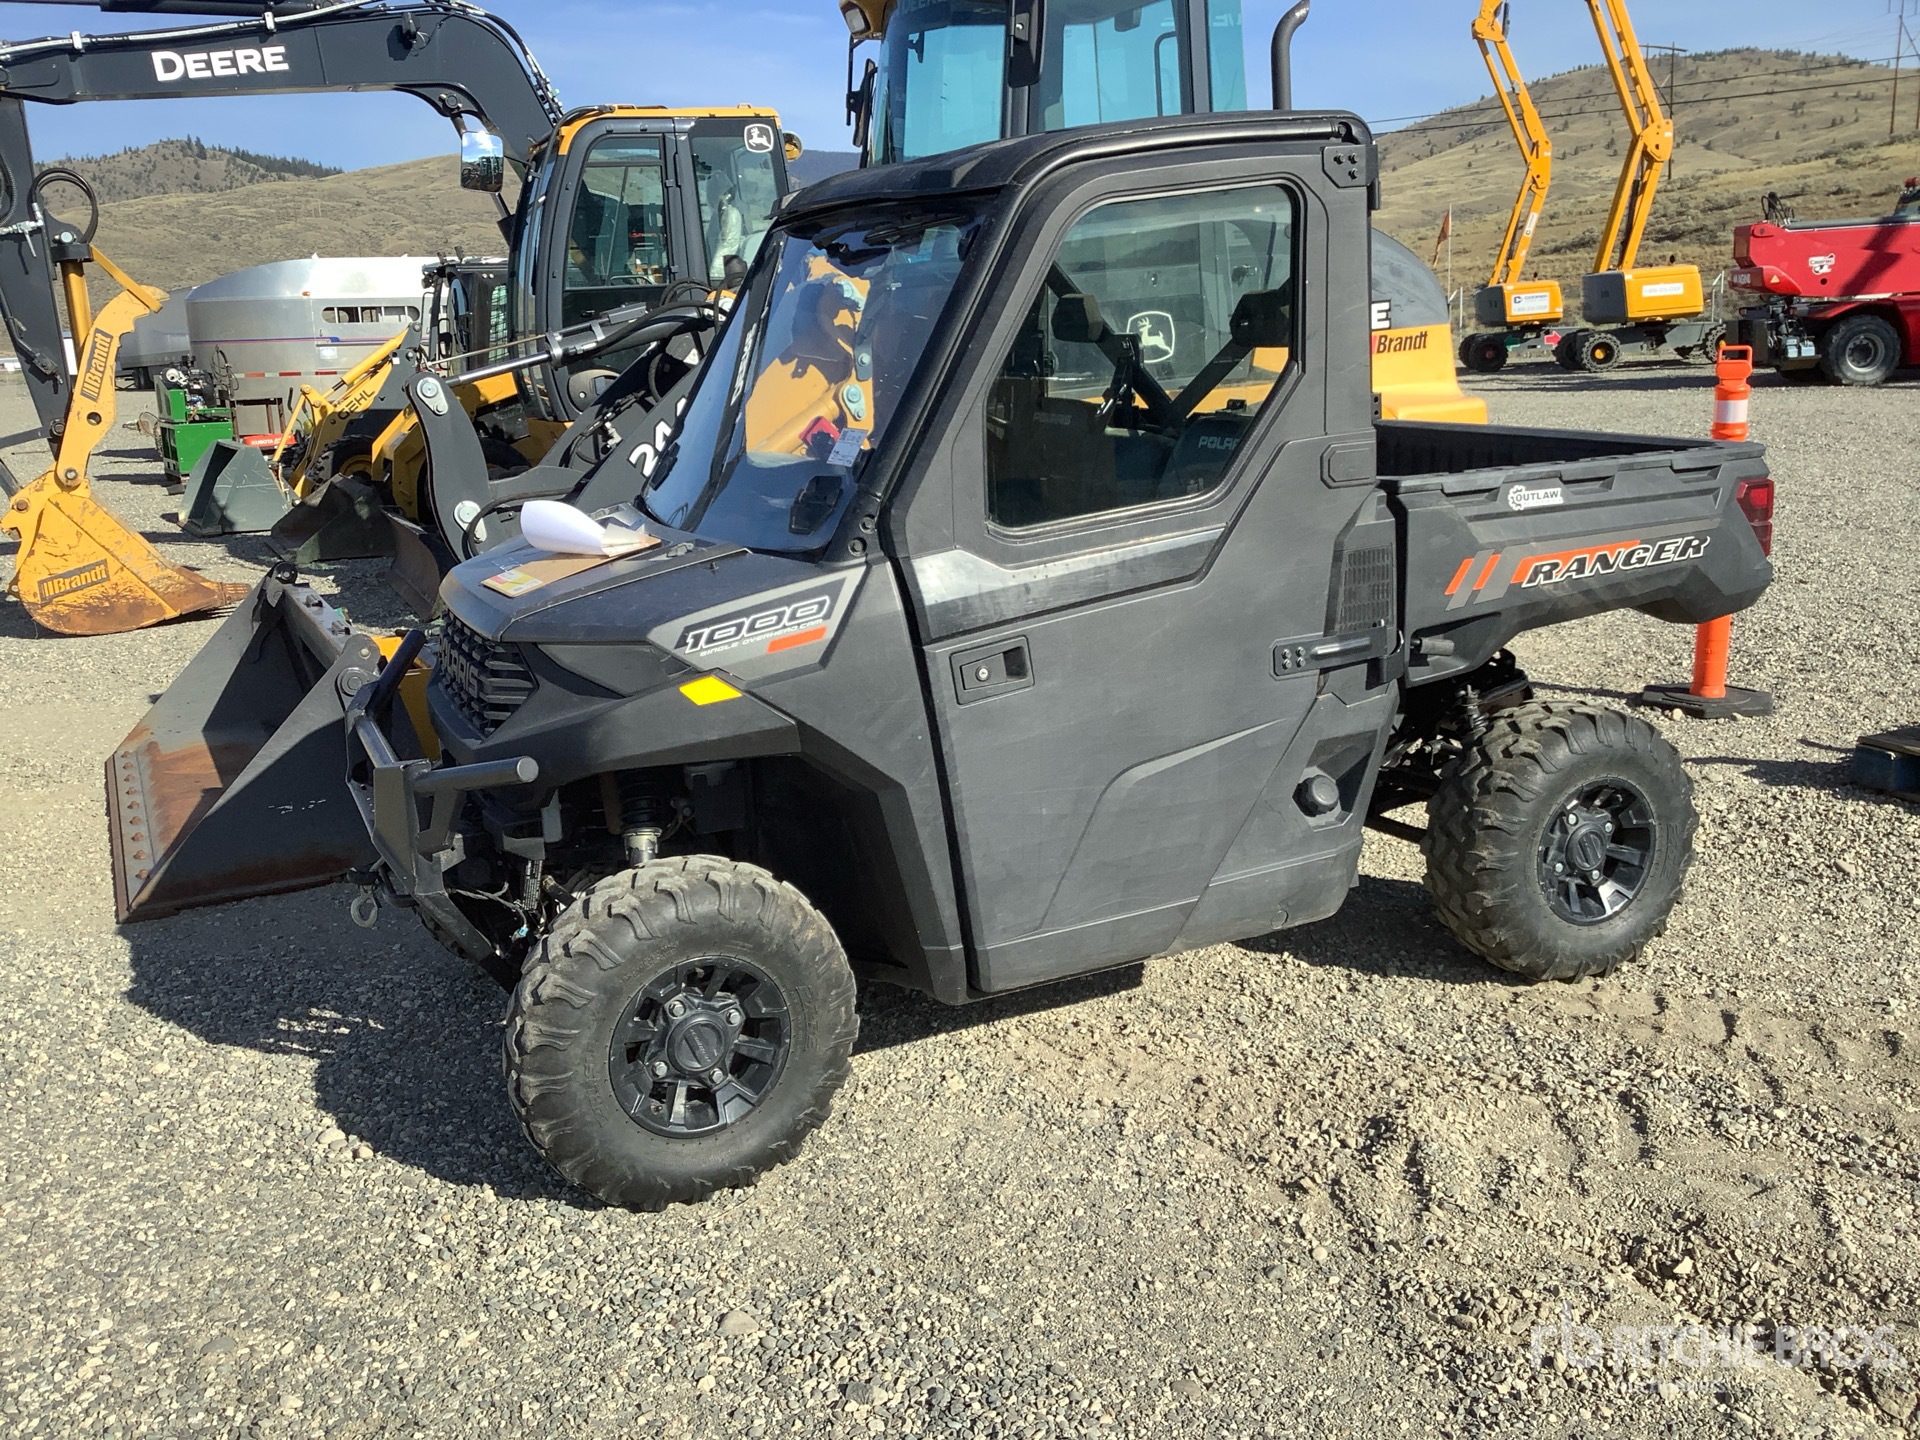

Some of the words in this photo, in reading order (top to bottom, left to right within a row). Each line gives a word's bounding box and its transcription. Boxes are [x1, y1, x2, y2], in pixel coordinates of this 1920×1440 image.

[151, 46, 289, 81] DEERE
[1377, 331, 1428, 354] Brandt
[338, 389, 375, 420] GEHL
[1515, 490, 1559, 502] OUTLAW
[1521, 536, 1711, 589] RANGER
[685, 595, 830, 653] 1000
[700, 641, 739, 657] SINGLE
[742, 625, 798, 645] OVERHEAD
[800, 619, 823, 630] CAM
